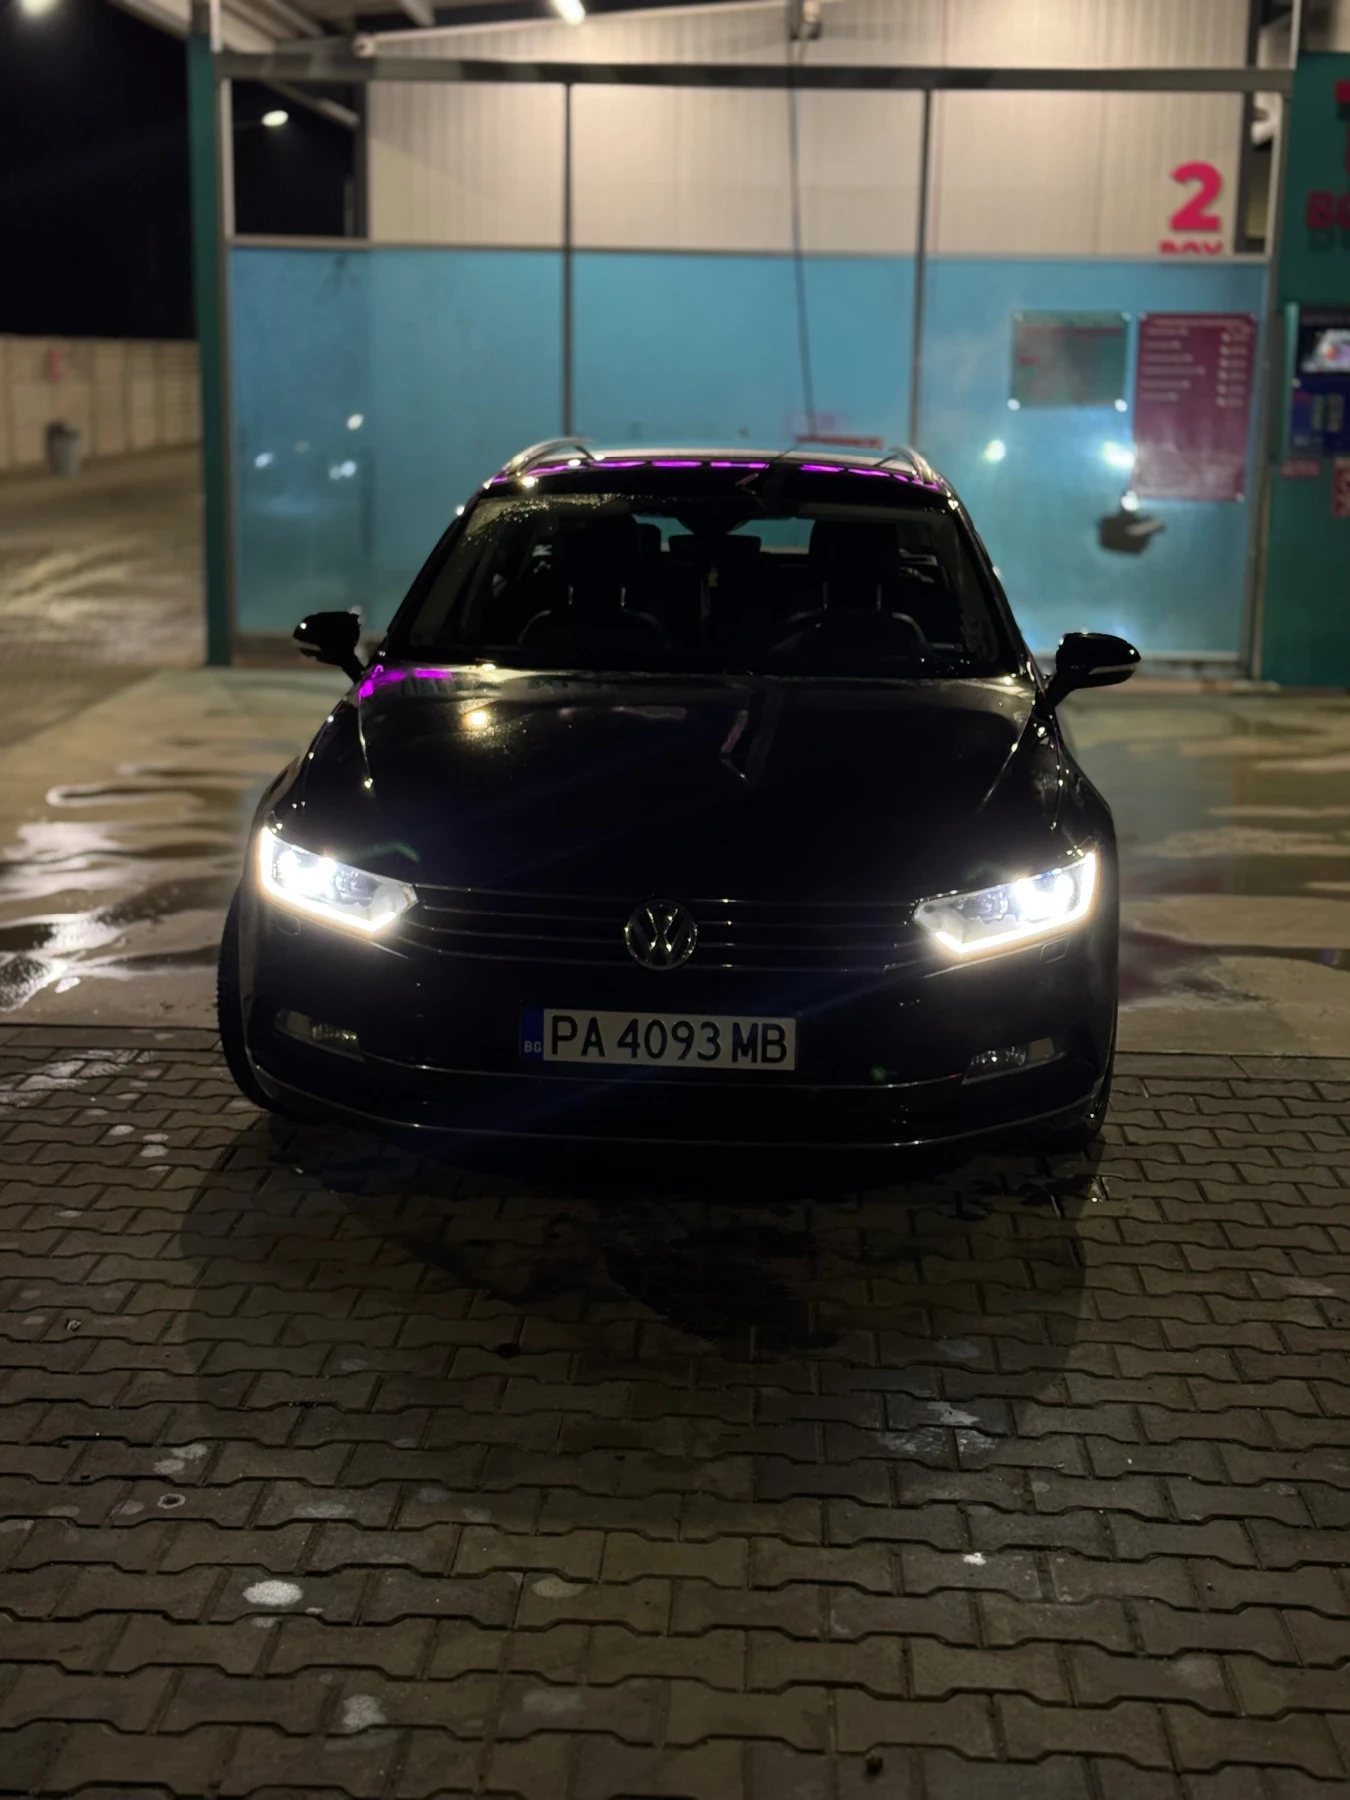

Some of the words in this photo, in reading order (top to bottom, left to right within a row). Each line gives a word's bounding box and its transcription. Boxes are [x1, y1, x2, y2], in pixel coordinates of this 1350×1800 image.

[1170, 160, 1222, 231] 2
[524, 1041, 541, 1053] BG
[551, 1015, 605, 1057] PA
[617, 1018, 722, 1061] 4093
[731, 1022, 787, 1063] MB
